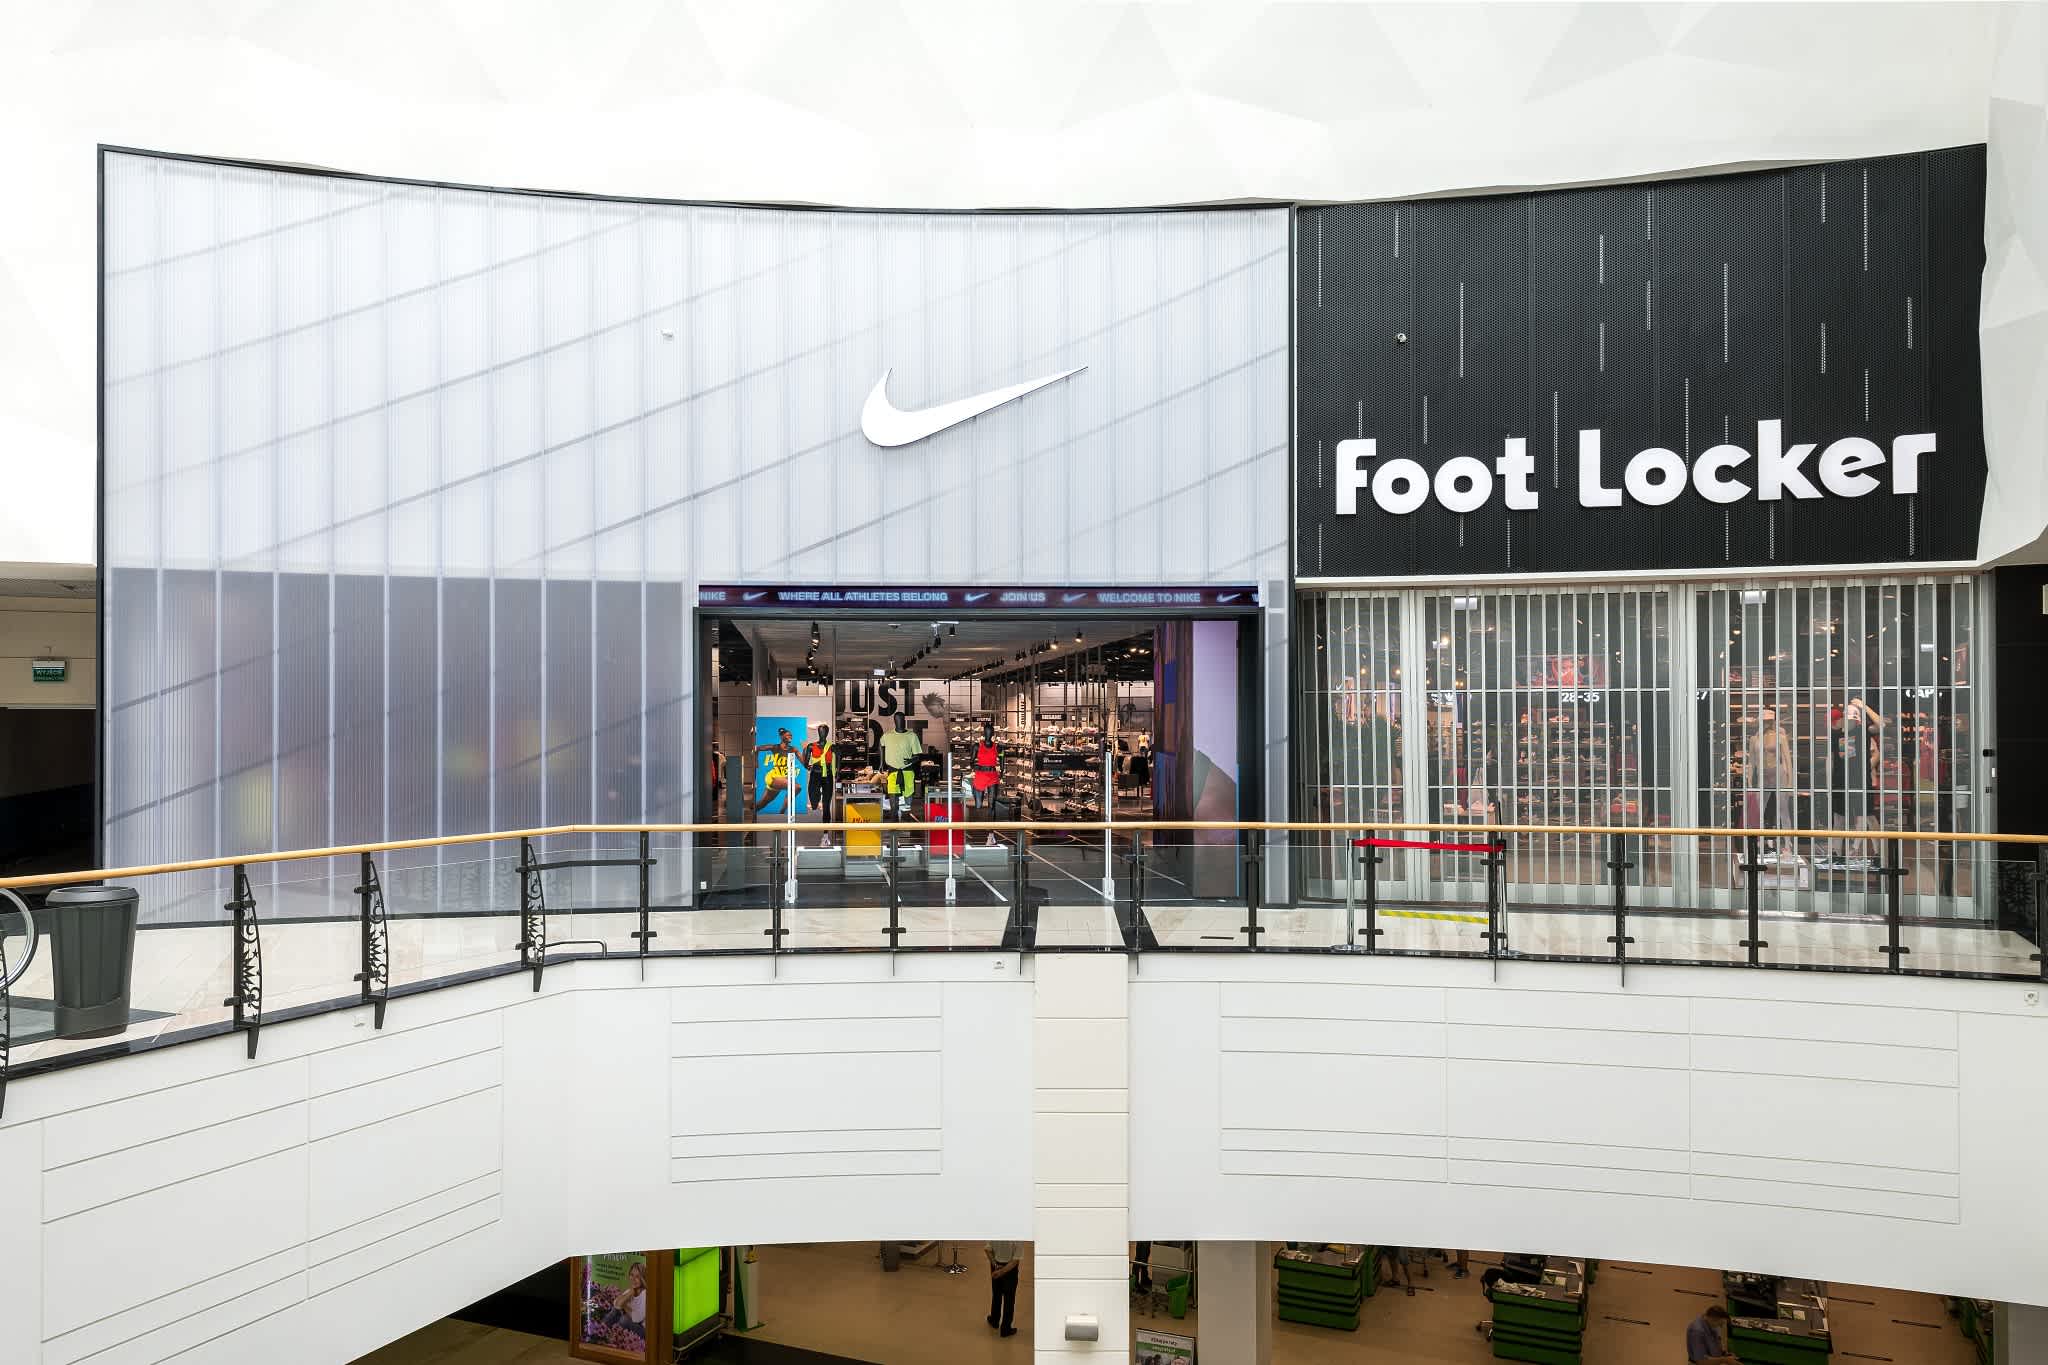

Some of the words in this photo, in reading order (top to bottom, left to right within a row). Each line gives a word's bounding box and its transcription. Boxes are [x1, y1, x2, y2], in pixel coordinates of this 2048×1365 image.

[1336, 437, 1538, 515] Foot
[1579, 419, 1937, 508] Locker
[700, 591, 727, 601] NIKE
[778, 591, 820, 601] WHERE
[821, 591, 843, 601] ALL
[843, 591, 900, 602] ATHLETES
[901, 591, 949, 602] BELONG
[1000, 592, 1027, 602] JOIN
[1028, 592, 1046, 602] US
[1096, 593, 1155, 603] WELCOME
[1157, 593, 1172, 603] TO
[1174, 593, 1201, 603] NIKE
